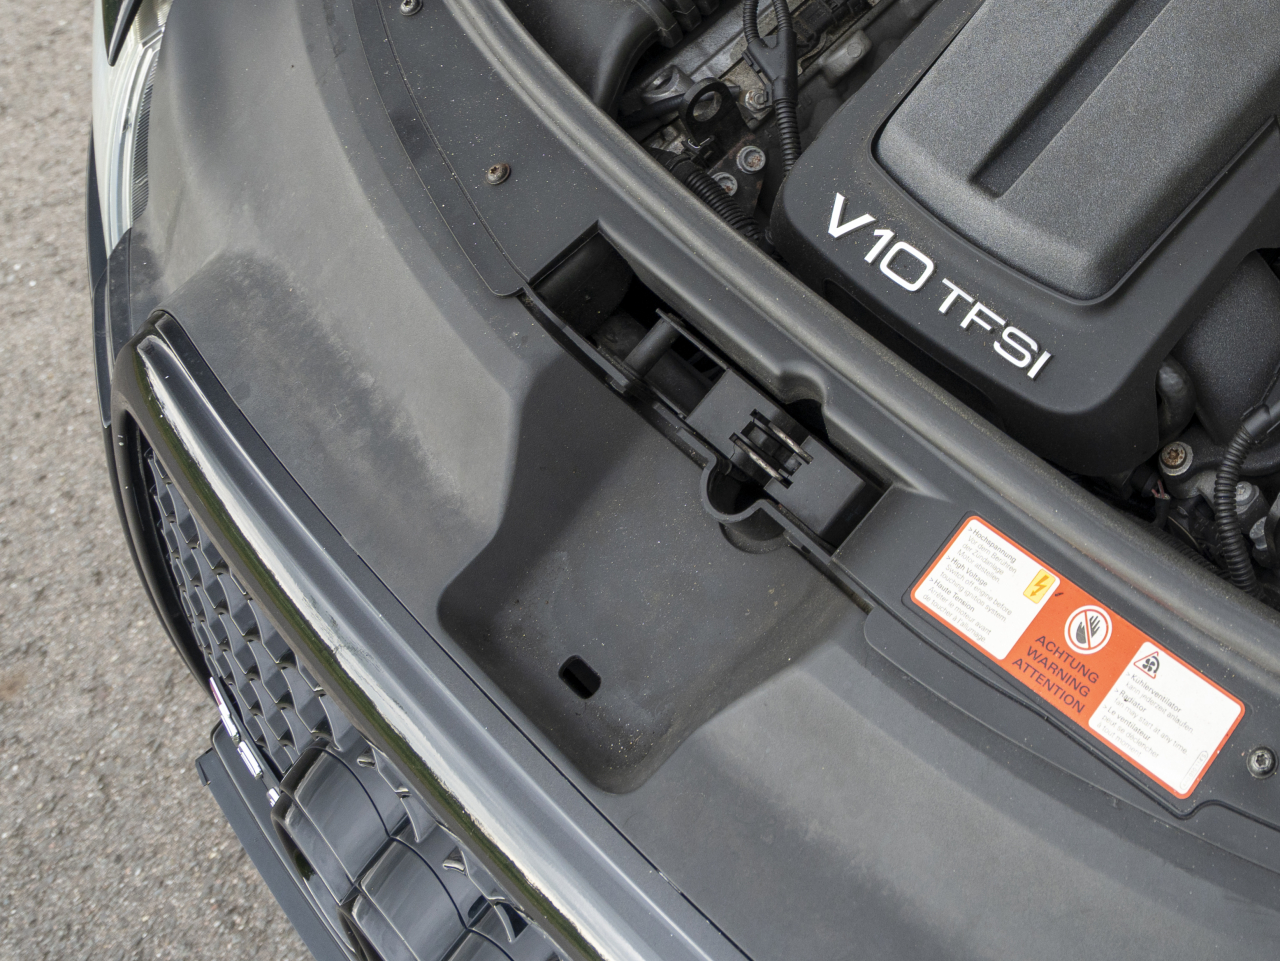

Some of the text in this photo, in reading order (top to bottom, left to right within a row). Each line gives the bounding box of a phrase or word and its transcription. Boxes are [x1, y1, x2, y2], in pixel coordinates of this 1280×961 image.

[827, 192, 1052, 380] V10 TFSI
[956, 548, 975, 564] Motor
[961, 543, 973, 552] der
[967, 535, 1017, 574] Vor dem Berühren
[972, 528, 1017, 564] Hochspannung
[939, 571, 965, 593] touching
[963, 589, 985, 607] ignition
[945, 564, 1013, 615] Switch off engine before
[950, 557, 988, 587] High Voltage
[927, 586, 949, 603] Arrêter
[953, 605, 975, 623] moteur
[974, 621, 991, 635] avant
[930, 599, 953, 618] toucher
[933, 578, 975, 612] Haute Tension
[1025, 645, 1091, 698] WARNING
[1034, 634, 1100, 684] ACHTUNG
[1011, 656, 1085, 714] ATTENTION
[1118, 689, 1147, 713] Radiator
[1125, 681, 1141, 695] kann
[1139, 692, 1167, 715] jederzeit
[1130, 673, 1182, 713] Kühlerventilator
[1101, 714, 1117, 728] peut
[1125, 731, 1160, 758] déclencher
[1107, 706, 1151, 741] Le ventilateur
[1114, 697, 1125, 708] fan
[1124, 706, 1138, 719] may
[1138, 716, 1153, 729] start
[1160, 732, 1172, 744] any
